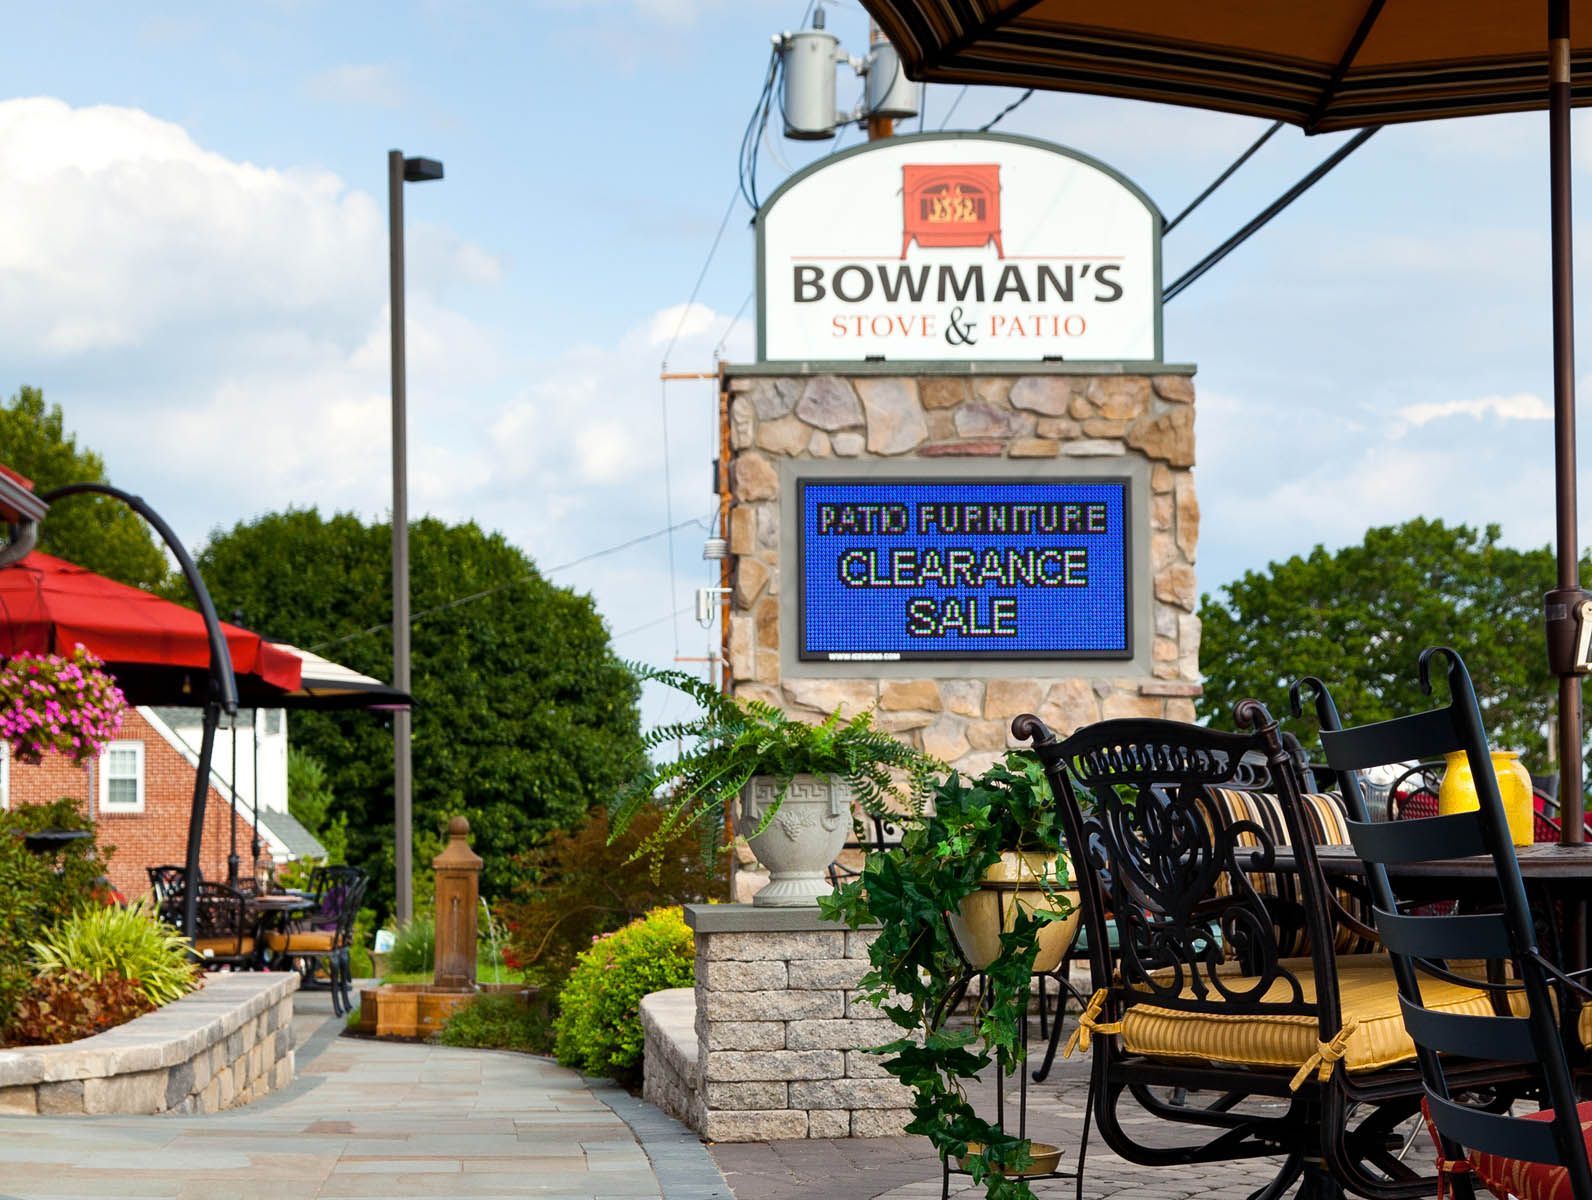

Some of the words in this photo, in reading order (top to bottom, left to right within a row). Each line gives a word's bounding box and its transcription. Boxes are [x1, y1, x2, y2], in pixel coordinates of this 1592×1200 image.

[793, 264, 1124, 303] BOWMAN'S
[831, 314, 937, 338] STOVE
[944, 305, 978, 346] &
[989, 314, 1088, 338] PATIO
[821, 505, 907, 533] PATIO
[920, 505, 1106, 533] FURNITURE
[841, 550, 1087, 586] CLEARANCE
[909, 599, 1016, 635] SALE
